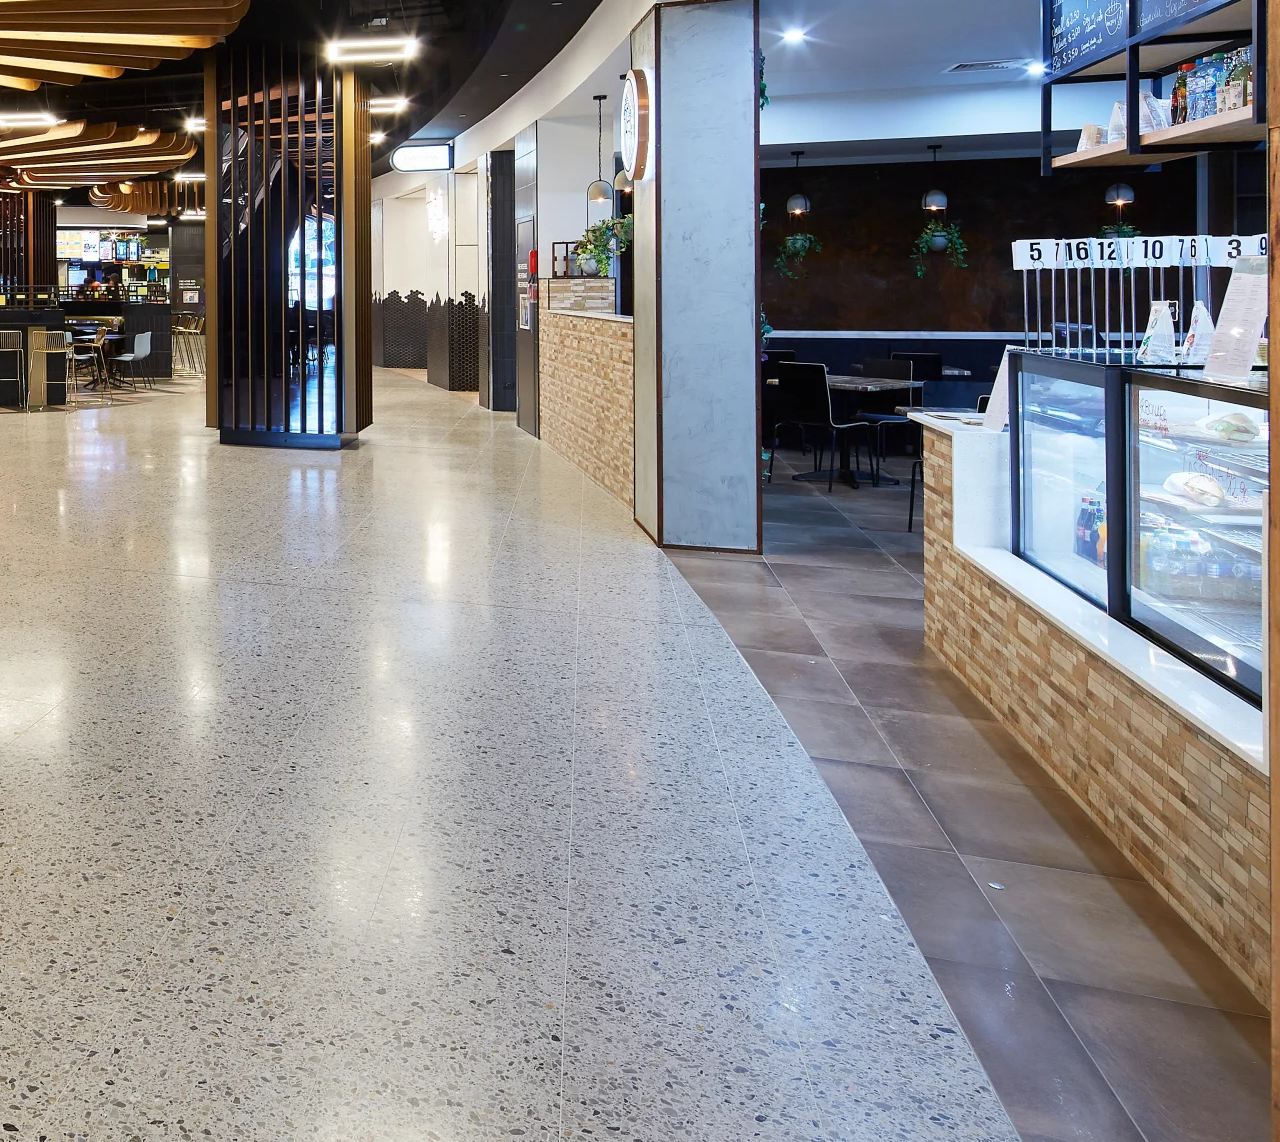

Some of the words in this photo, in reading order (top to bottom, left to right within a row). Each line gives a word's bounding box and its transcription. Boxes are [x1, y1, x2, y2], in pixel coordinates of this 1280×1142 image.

[1029, 242, 1042, 261] 5
[1098, 242, 1117, 261] 12
[1141, 239, 1164, 260] 10
[1178, 239, 1185, 258] 7
[1190, 238, 1197, 258] 6
[1227, 239, 1242, 259] 3
[1259, 236, 1268, 256] 9
